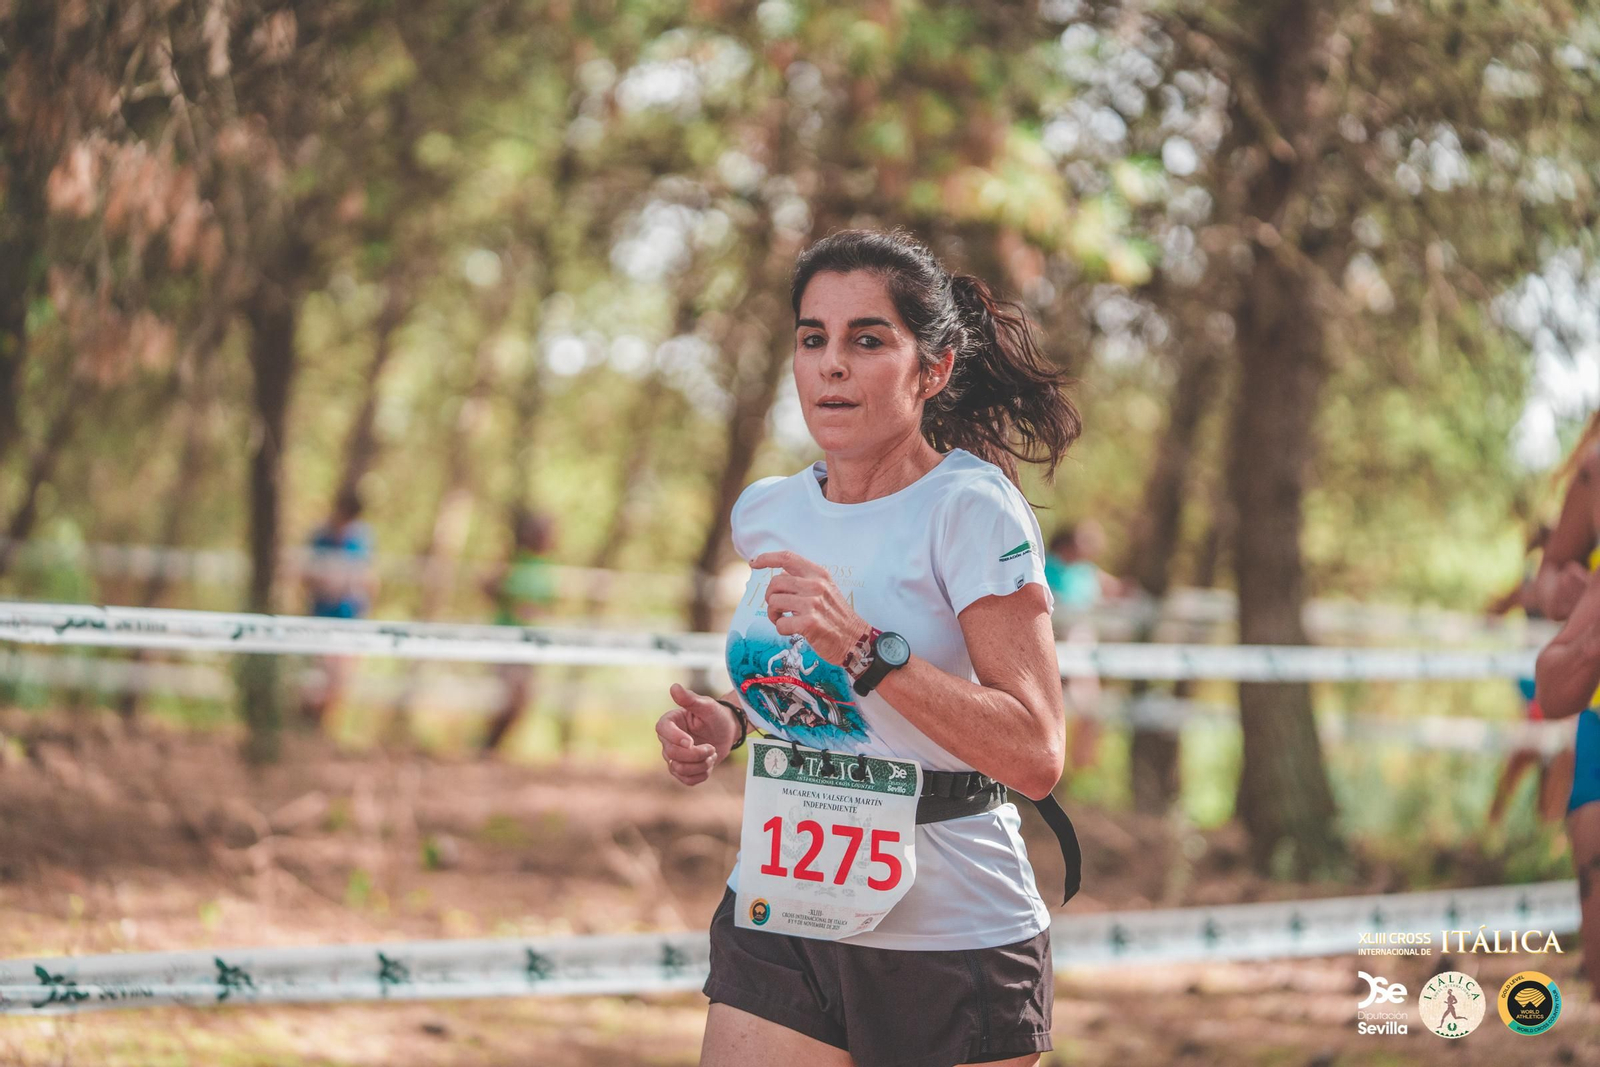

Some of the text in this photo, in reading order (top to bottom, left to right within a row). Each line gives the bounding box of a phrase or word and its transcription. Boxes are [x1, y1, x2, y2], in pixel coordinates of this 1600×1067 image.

[782, 788, 883, 807] MACARENA VALSECA MARTÍN
[803, 800, 858, 814] INDEPENDIENTE
[761, 816, 903, 891] 1275
